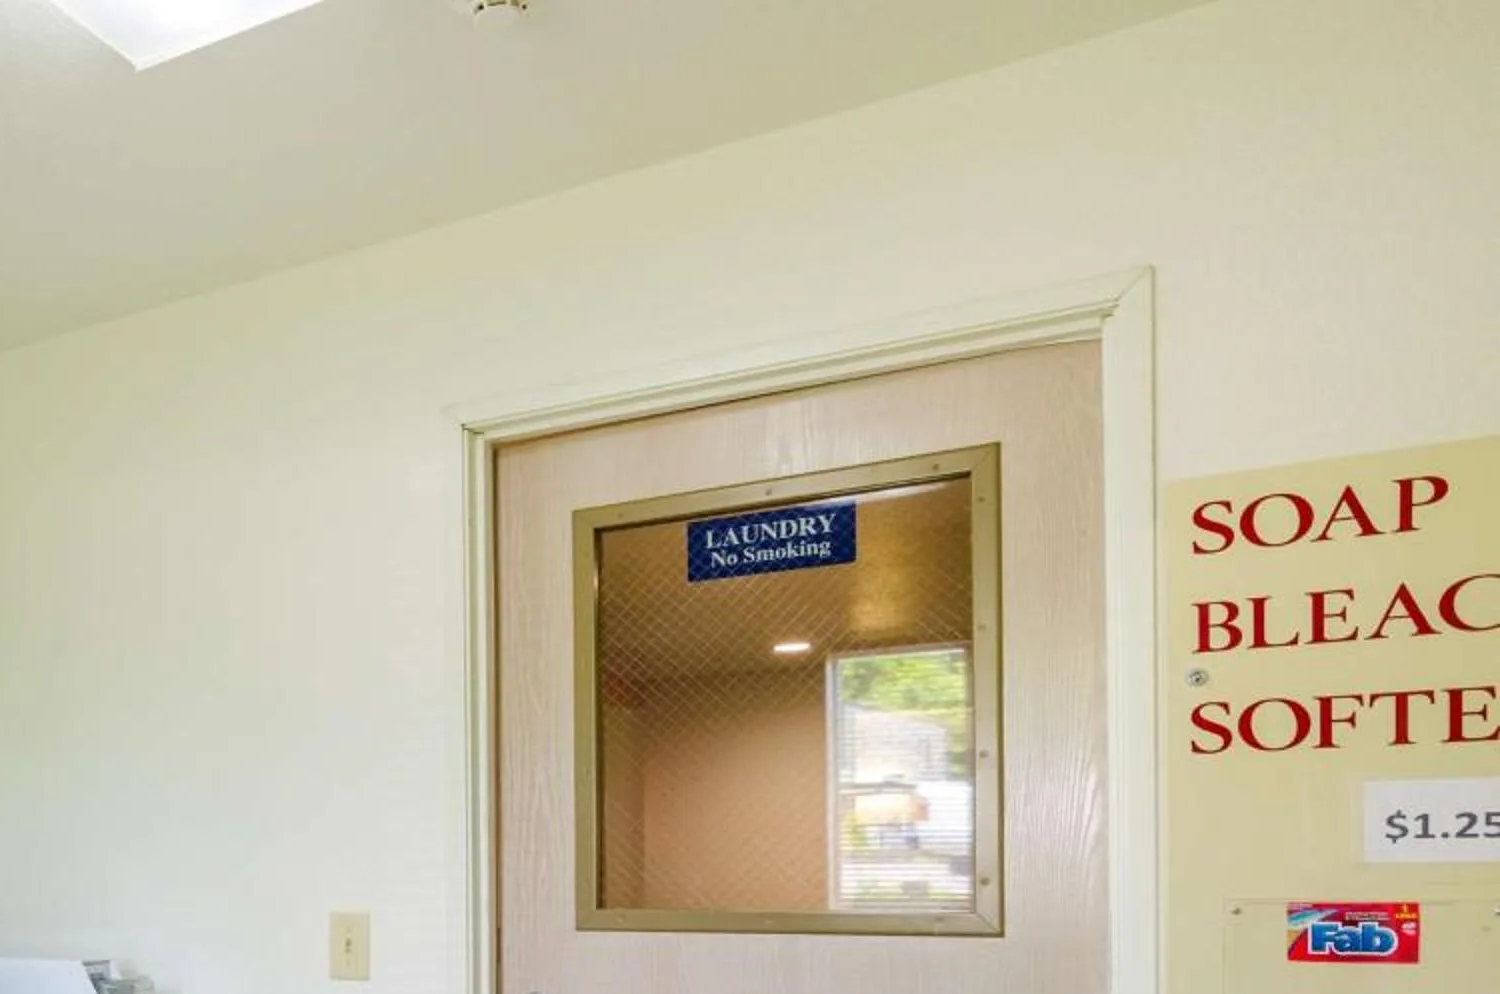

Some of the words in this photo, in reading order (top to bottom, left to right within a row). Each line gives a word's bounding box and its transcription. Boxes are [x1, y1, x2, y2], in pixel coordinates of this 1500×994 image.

[705, 513, 836, 549] LAUNDRY
[1191, 475, 1450, 555] SOAP
[711, 551, 738, 568] No
[743, 540, 831, 564] Smoking
[1191, 573, 1500, 655] BLEAC
[1190, 685, 1500, 755] SOFTE
[1384, 809, 1500, 844] $1.25
[1309, 921, 1397, 955] Fab
